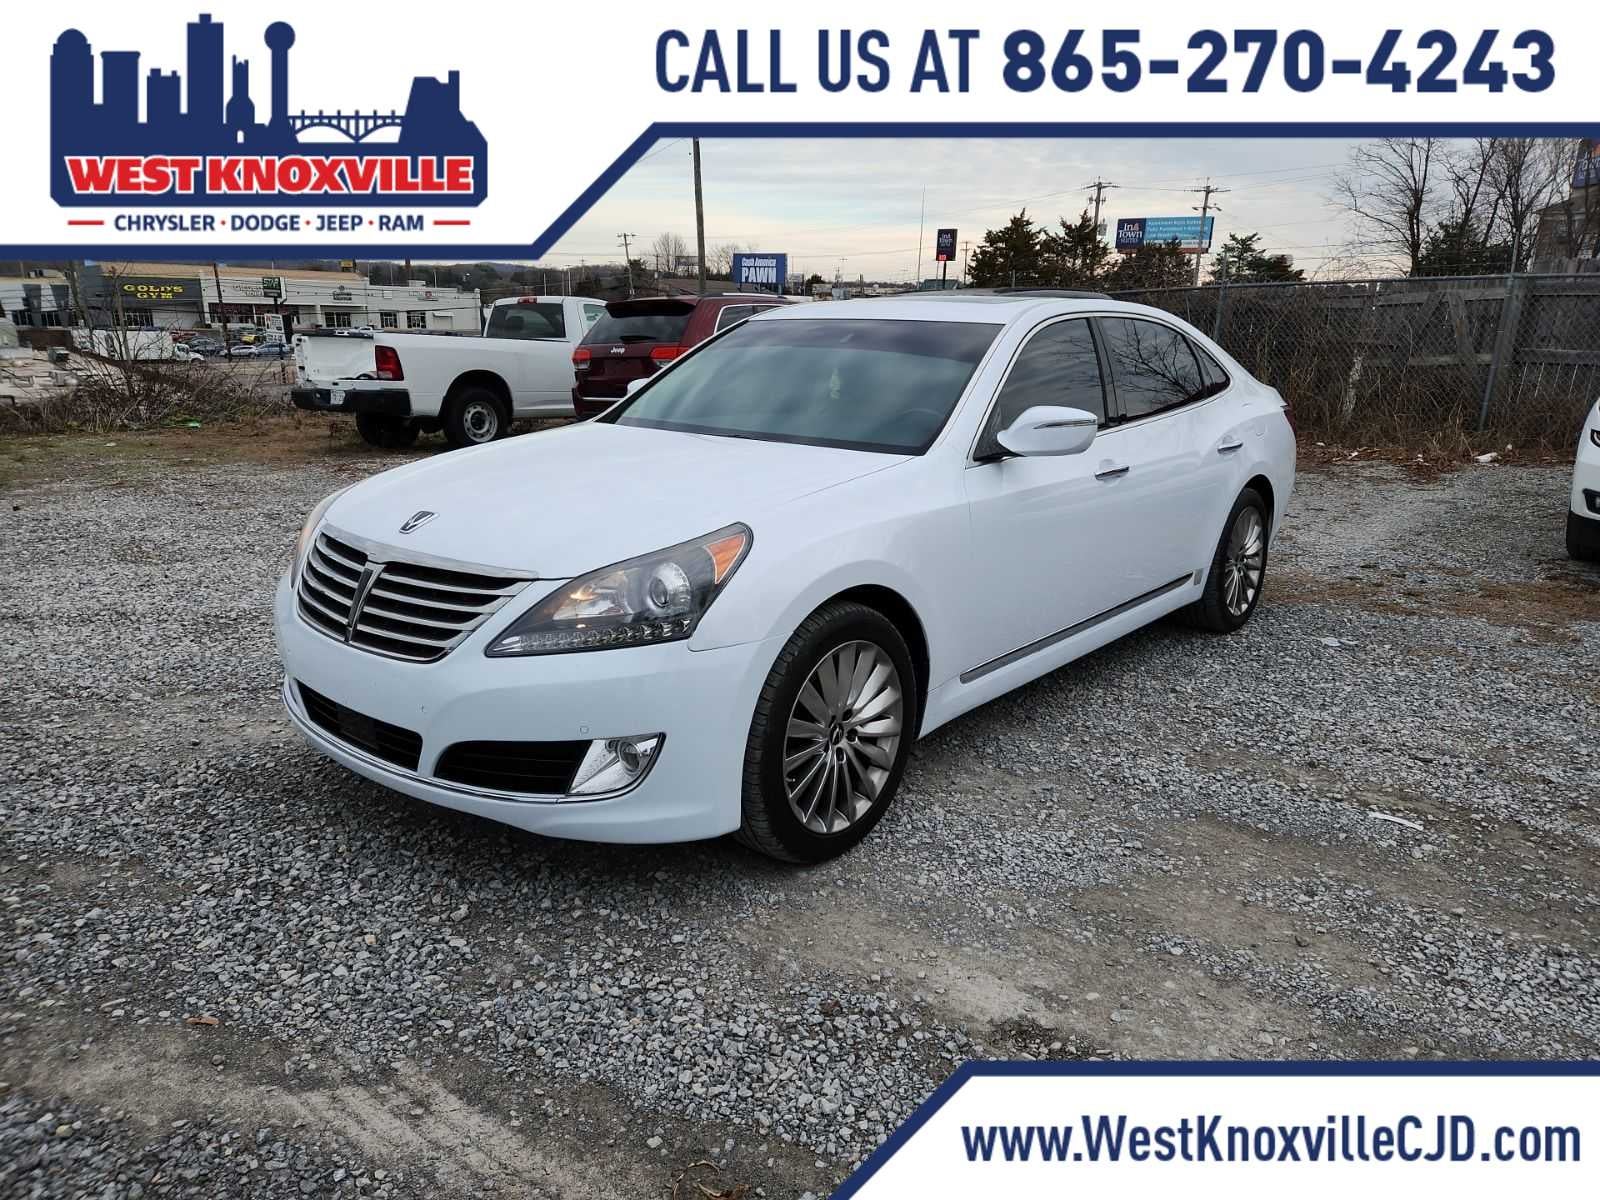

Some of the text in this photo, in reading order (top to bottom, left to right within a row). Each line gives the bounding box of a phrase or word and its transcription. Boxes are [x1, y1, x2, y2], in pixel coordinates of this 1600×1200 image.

[1118, 230, 1142, 239] Town
[741, 267, 777, 283] PAWN
[610, 346, 626, 354] Jeep
